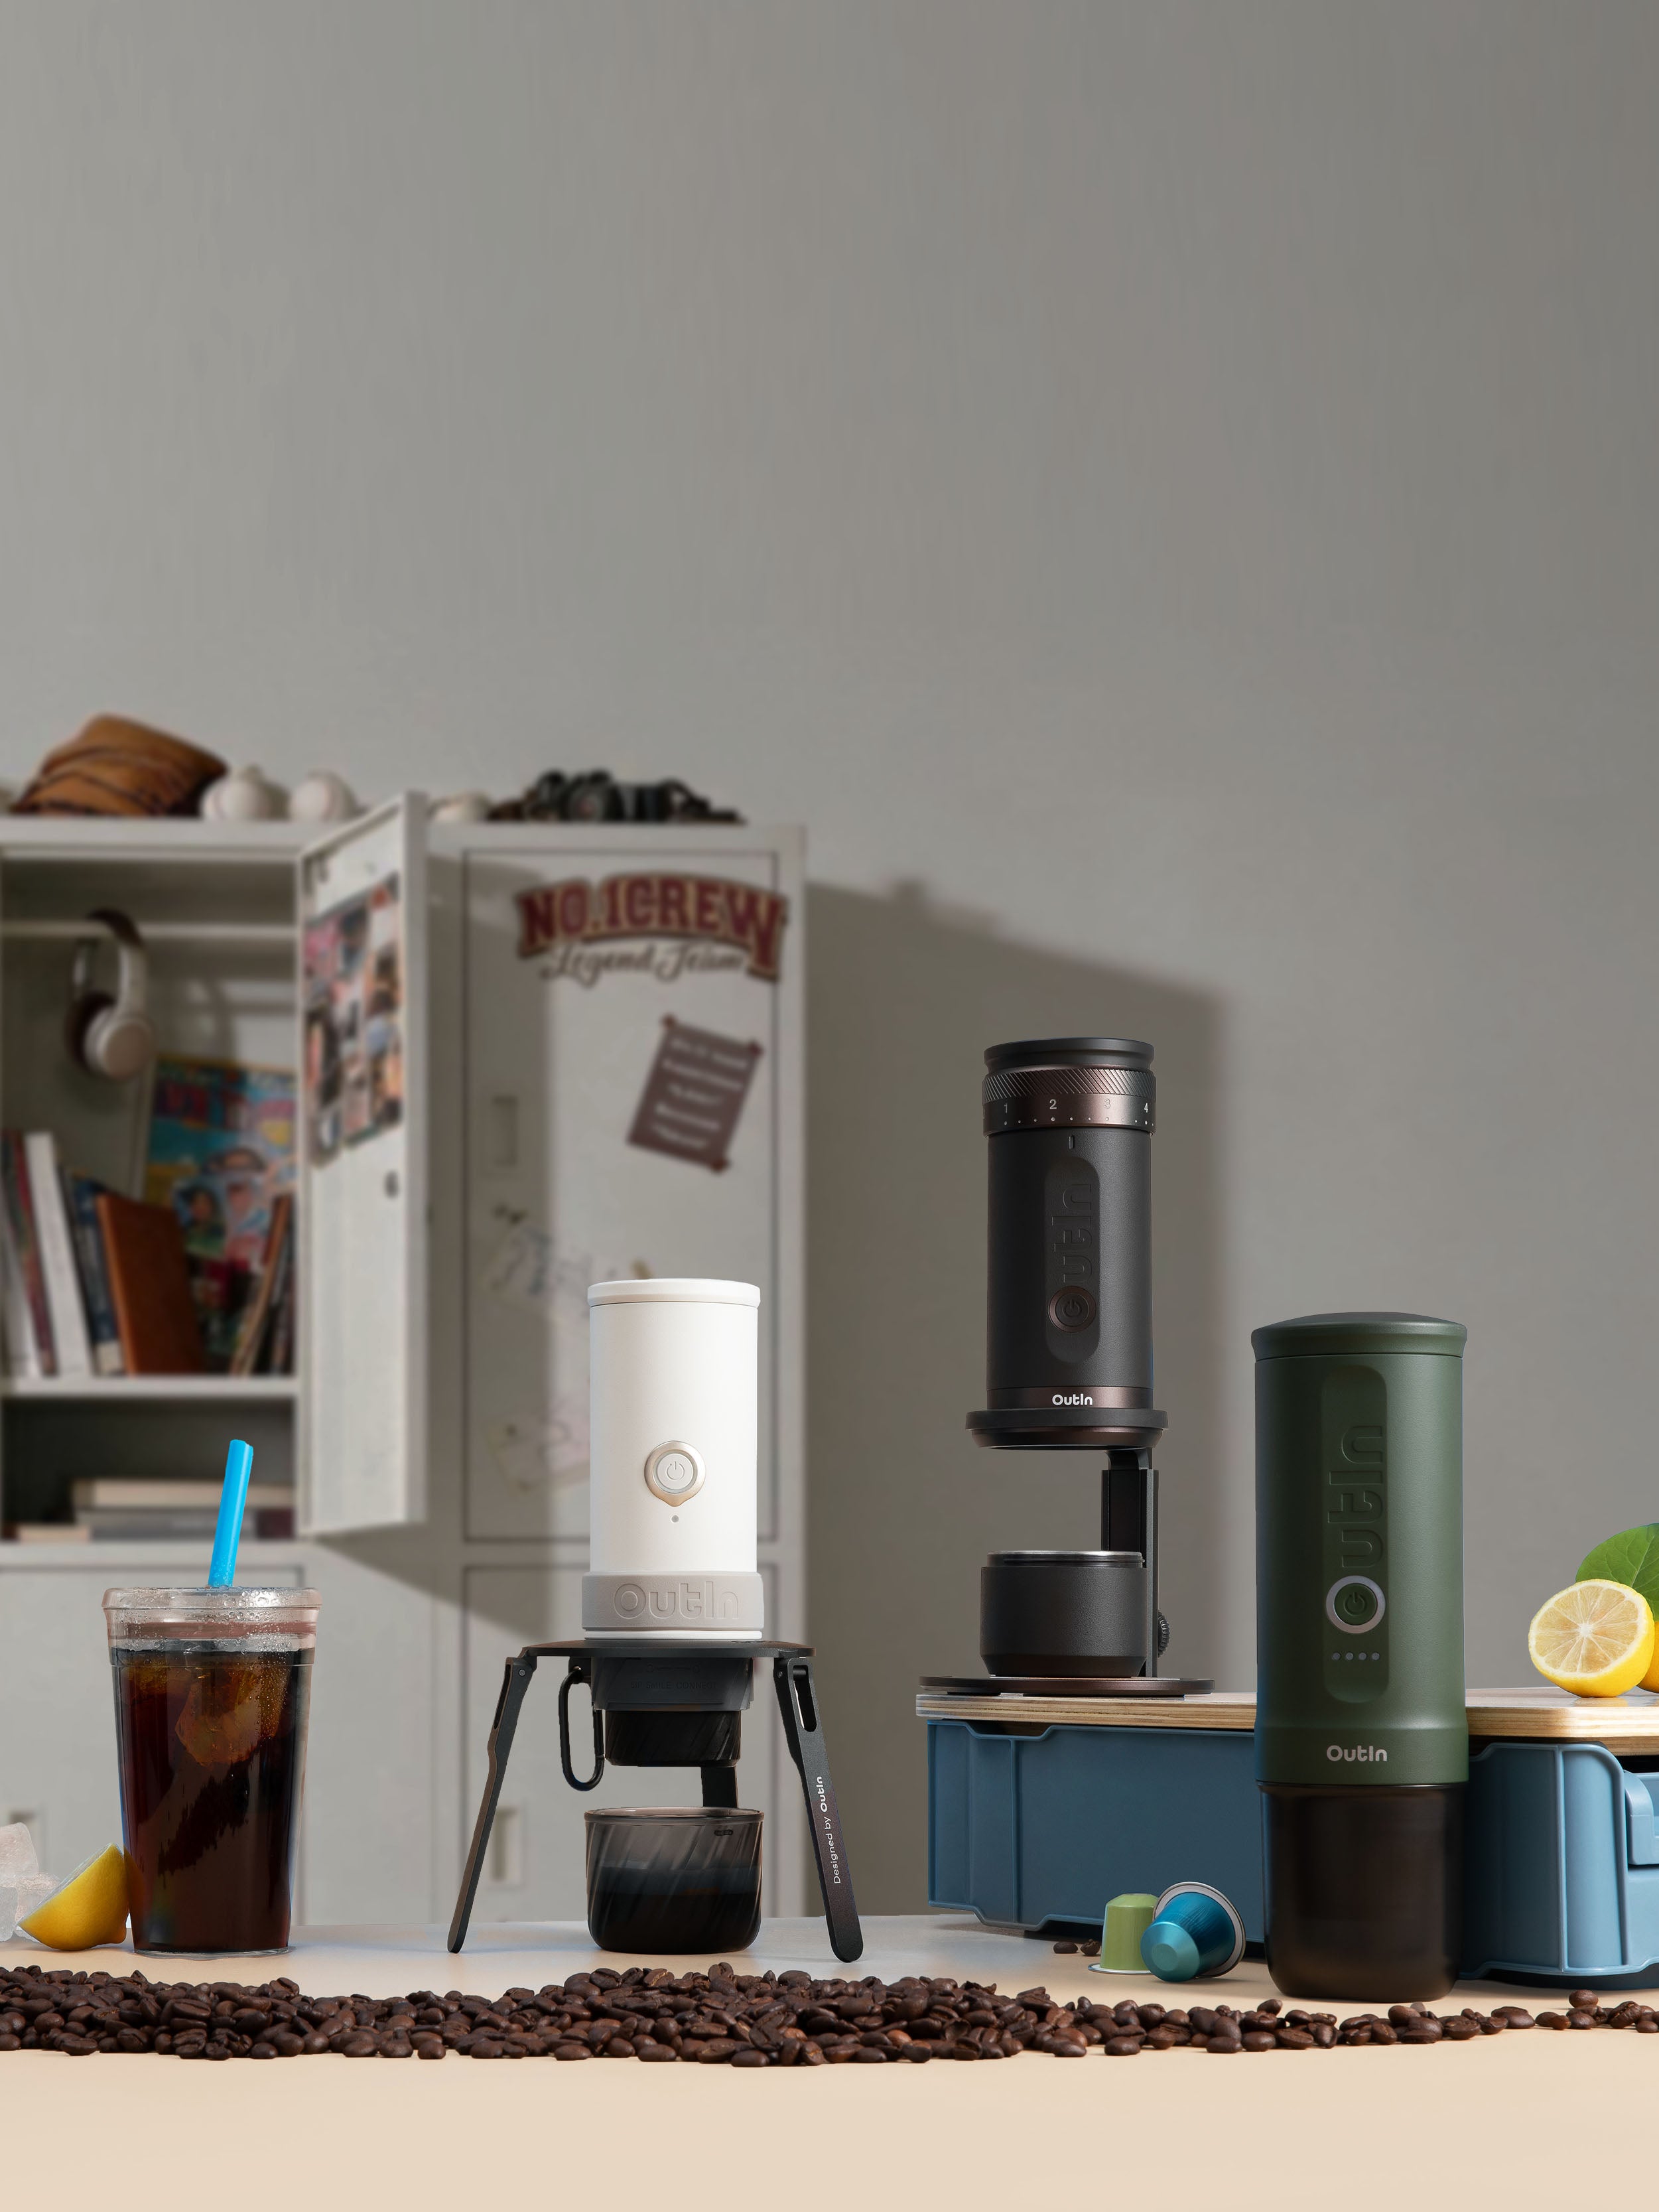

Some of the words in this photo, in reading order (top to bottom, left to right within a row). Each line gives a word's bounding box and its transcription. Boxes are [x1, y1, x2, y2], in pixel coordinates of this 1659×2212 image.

[539, 942, 656, 990] Legend
[657, 945, 744, 983] Team
[1049, 1099, 1057, 1110] 2
[1103, 1098, 1111, 1109] 3
[1144, 1102, 1149, 1113] 4
[645, 1681, 672, 1689] SMILE
[676, 1681, 717, 1689] CONNECT
[824, 1816, 832, 1830] by
[825, 1833, 841, 1884] Designed
